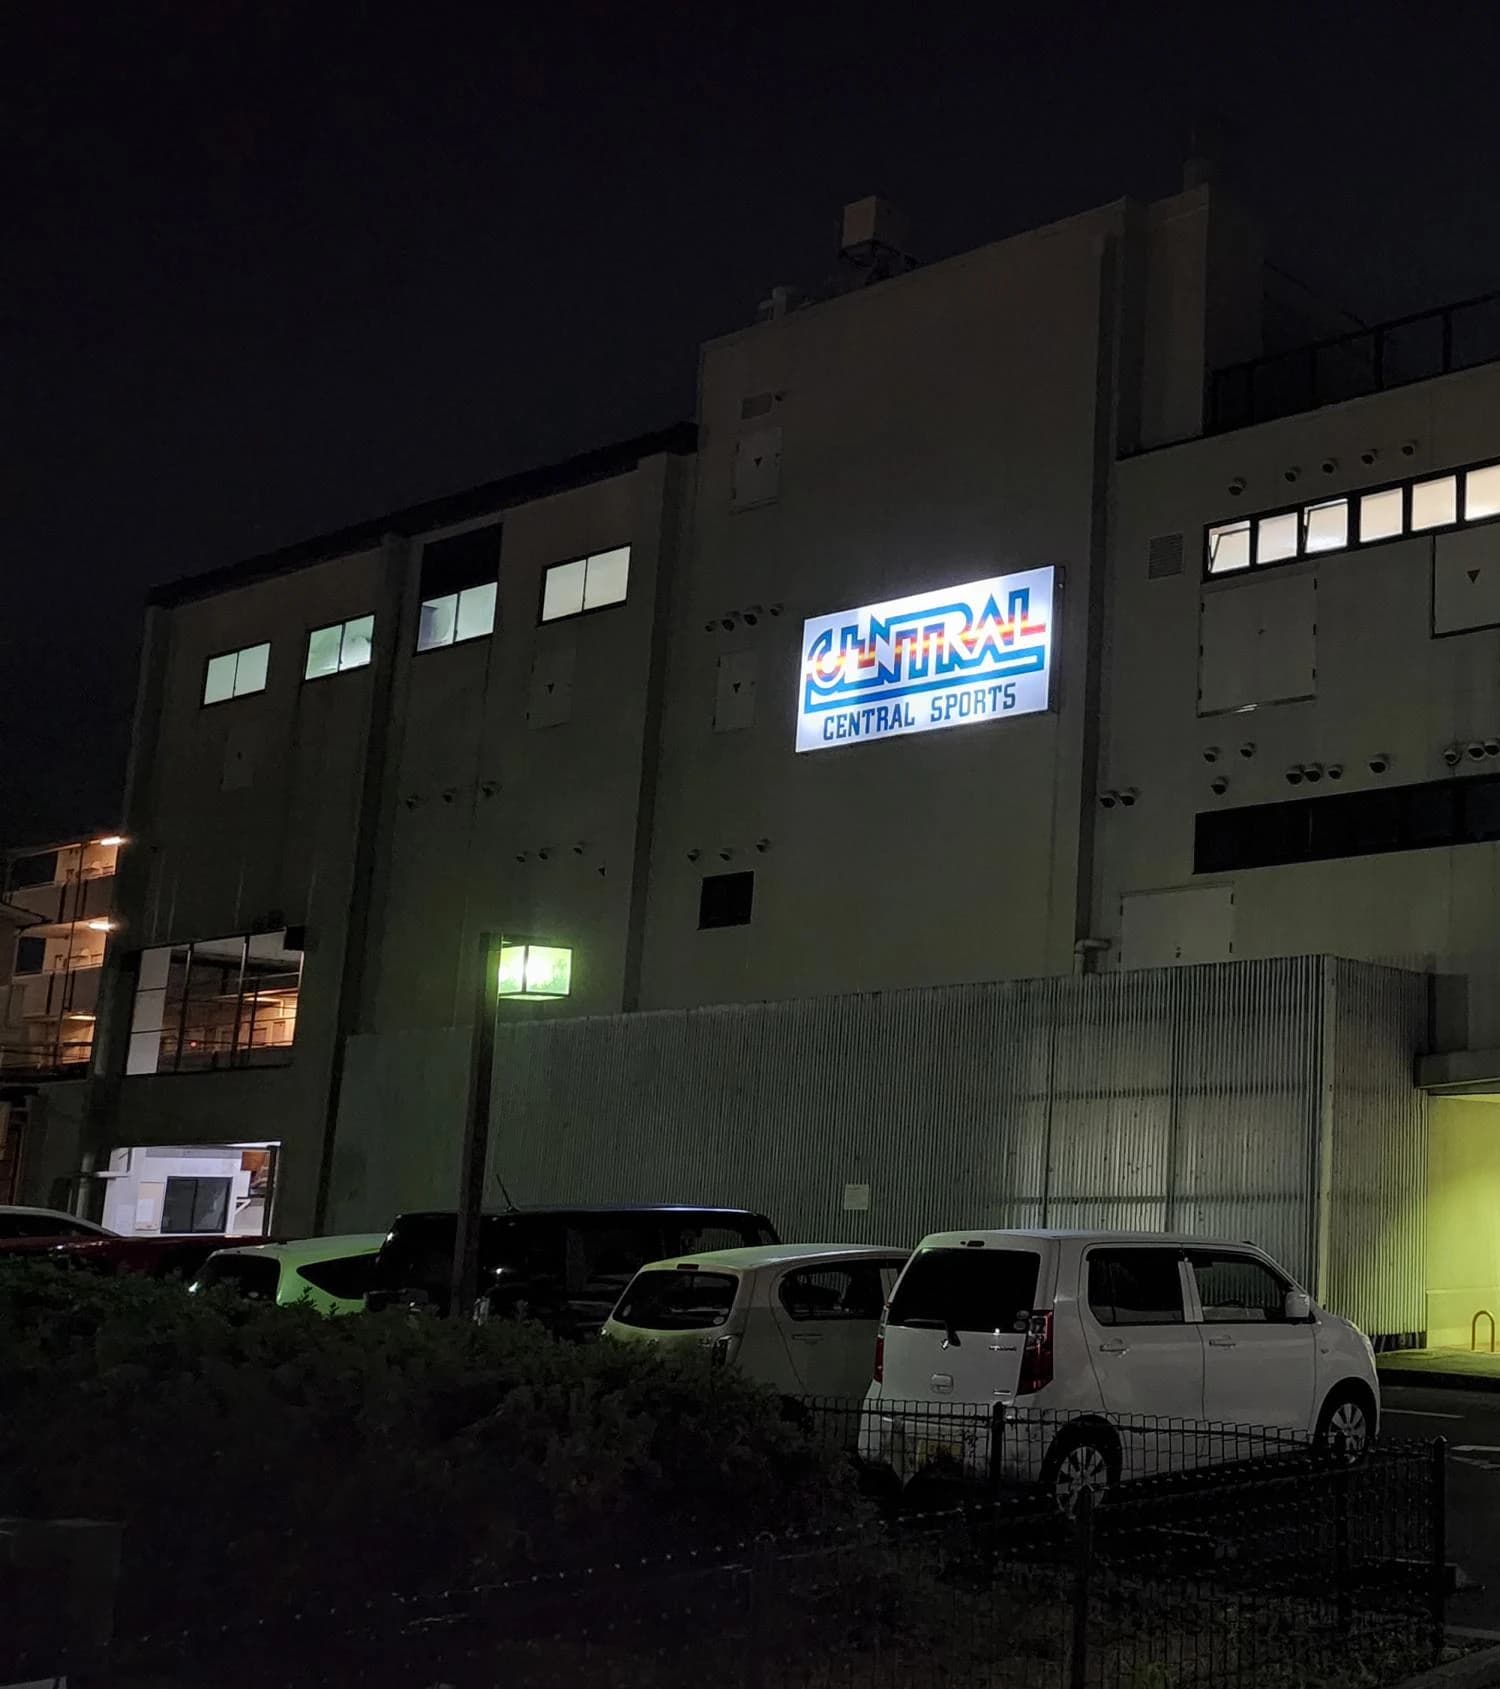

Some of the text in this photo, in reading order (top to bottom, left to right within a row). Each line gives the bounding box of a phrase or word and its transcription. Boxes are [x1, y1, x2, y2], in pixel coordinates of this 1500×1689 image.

[804, 587, 1046, 691] CENTRAL
[823, 683, 1016, 741] CENTRAL SPORTS
